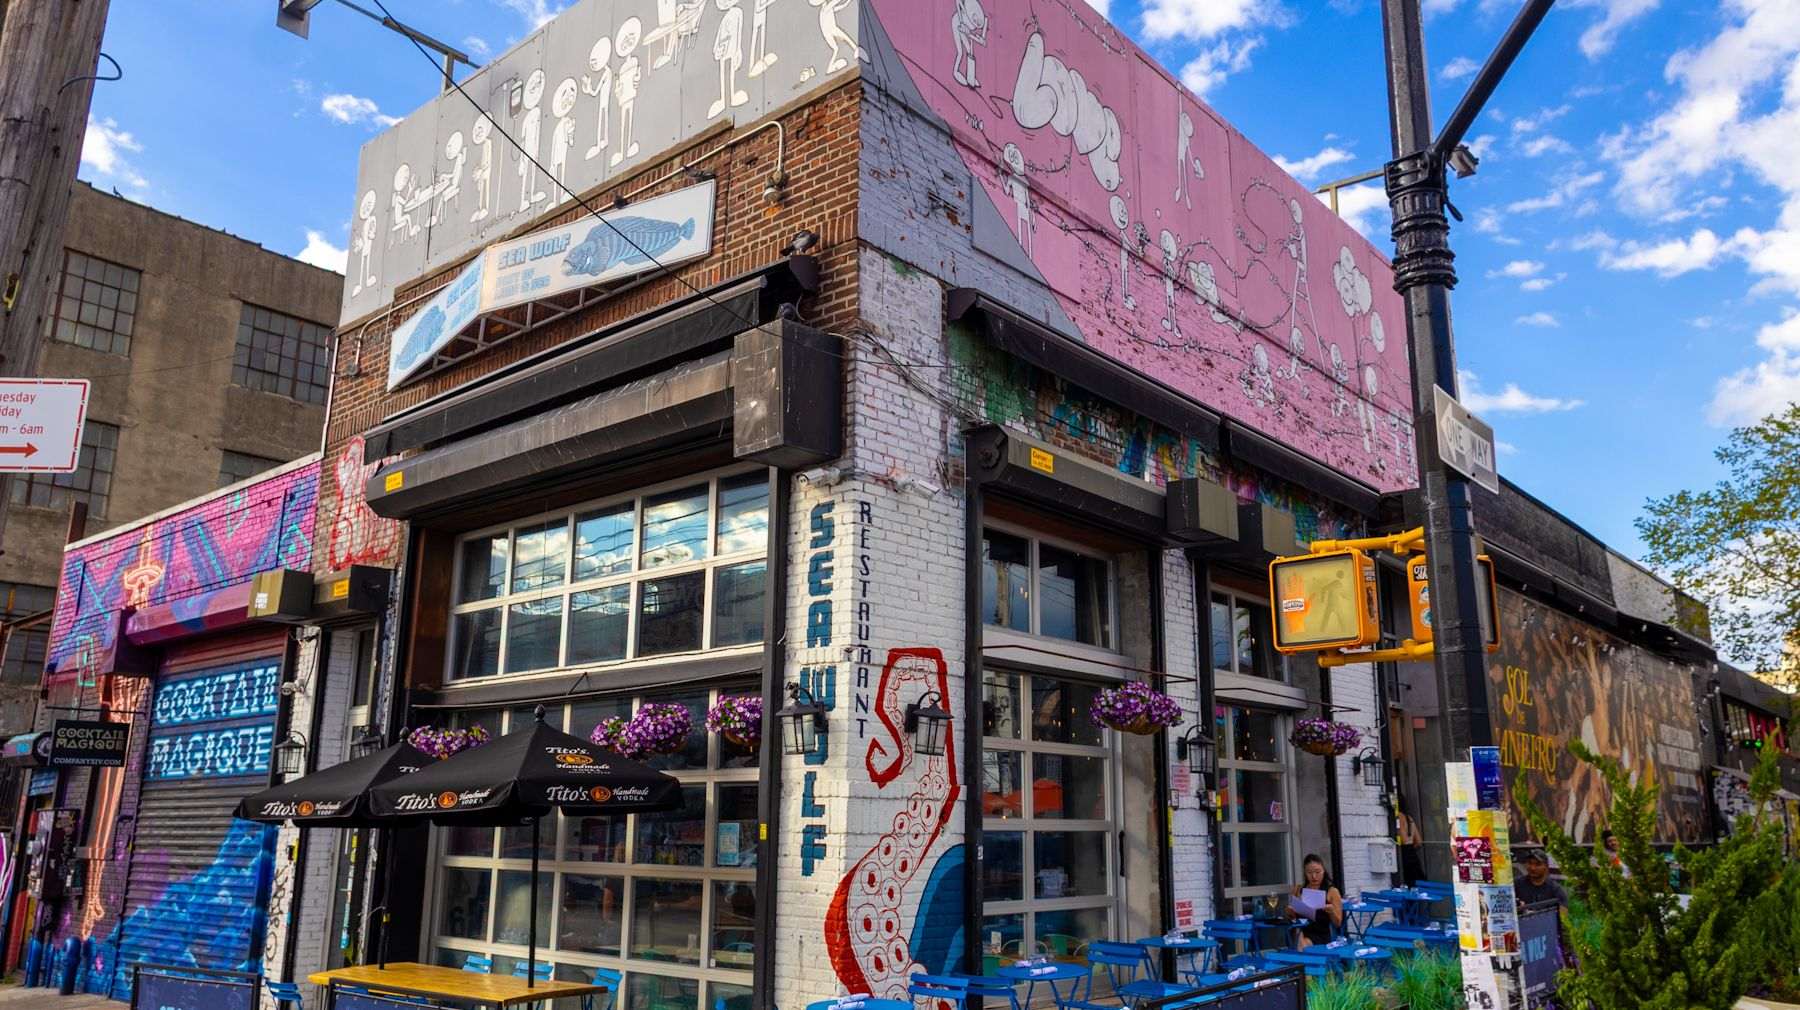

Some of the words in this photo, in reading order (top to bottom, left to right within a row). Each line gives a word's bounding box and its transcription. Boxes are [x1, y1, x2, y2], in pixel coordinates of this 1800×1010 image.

[498, 246, 526, 270] SEA
[528, 232, 571, 261] WOLF
[20, 424, 44, 434] 6am
[855, 501, 873, 738] RESTAURANT
[156, 666, 278, 723] COCKTAIL
[57, 728, 125, 740] COCKTAIL
[56, 738, 124, 751] MAGIQUE
[150, 726, 273, 777] MAGIQUE
[546, 747, 588, 755] Tito's
[394, 792, 437, 810] Tito's
[546, 785, 588, 801] Tito's
[260, 801, 297, 816] Tito's
